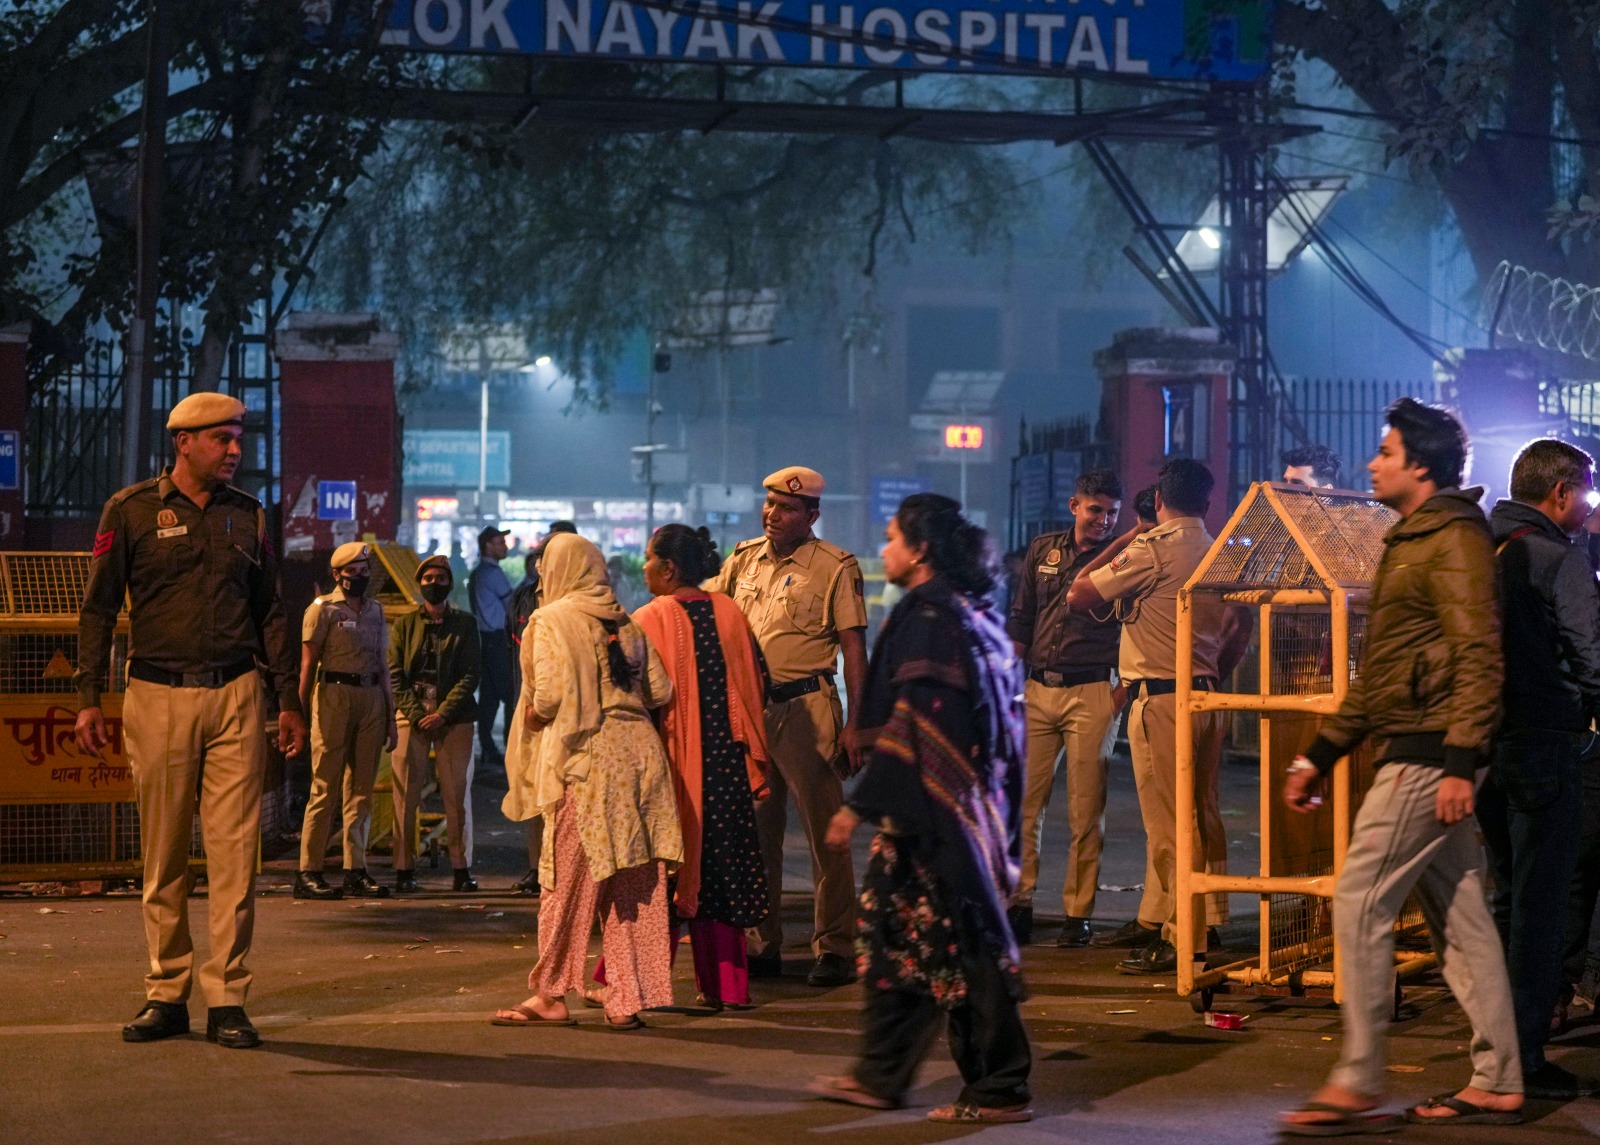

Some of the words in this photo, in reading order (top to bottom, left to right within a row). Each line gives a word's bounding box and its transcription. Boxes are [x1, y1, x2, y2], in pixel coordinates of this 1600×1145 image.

[545, 0, 786, 61] NAYAK
[810, 4, 1149, 74] HOSPITAL
[326, 492, 350, 509] IN
[88, 762, 132, 788] दरिया
